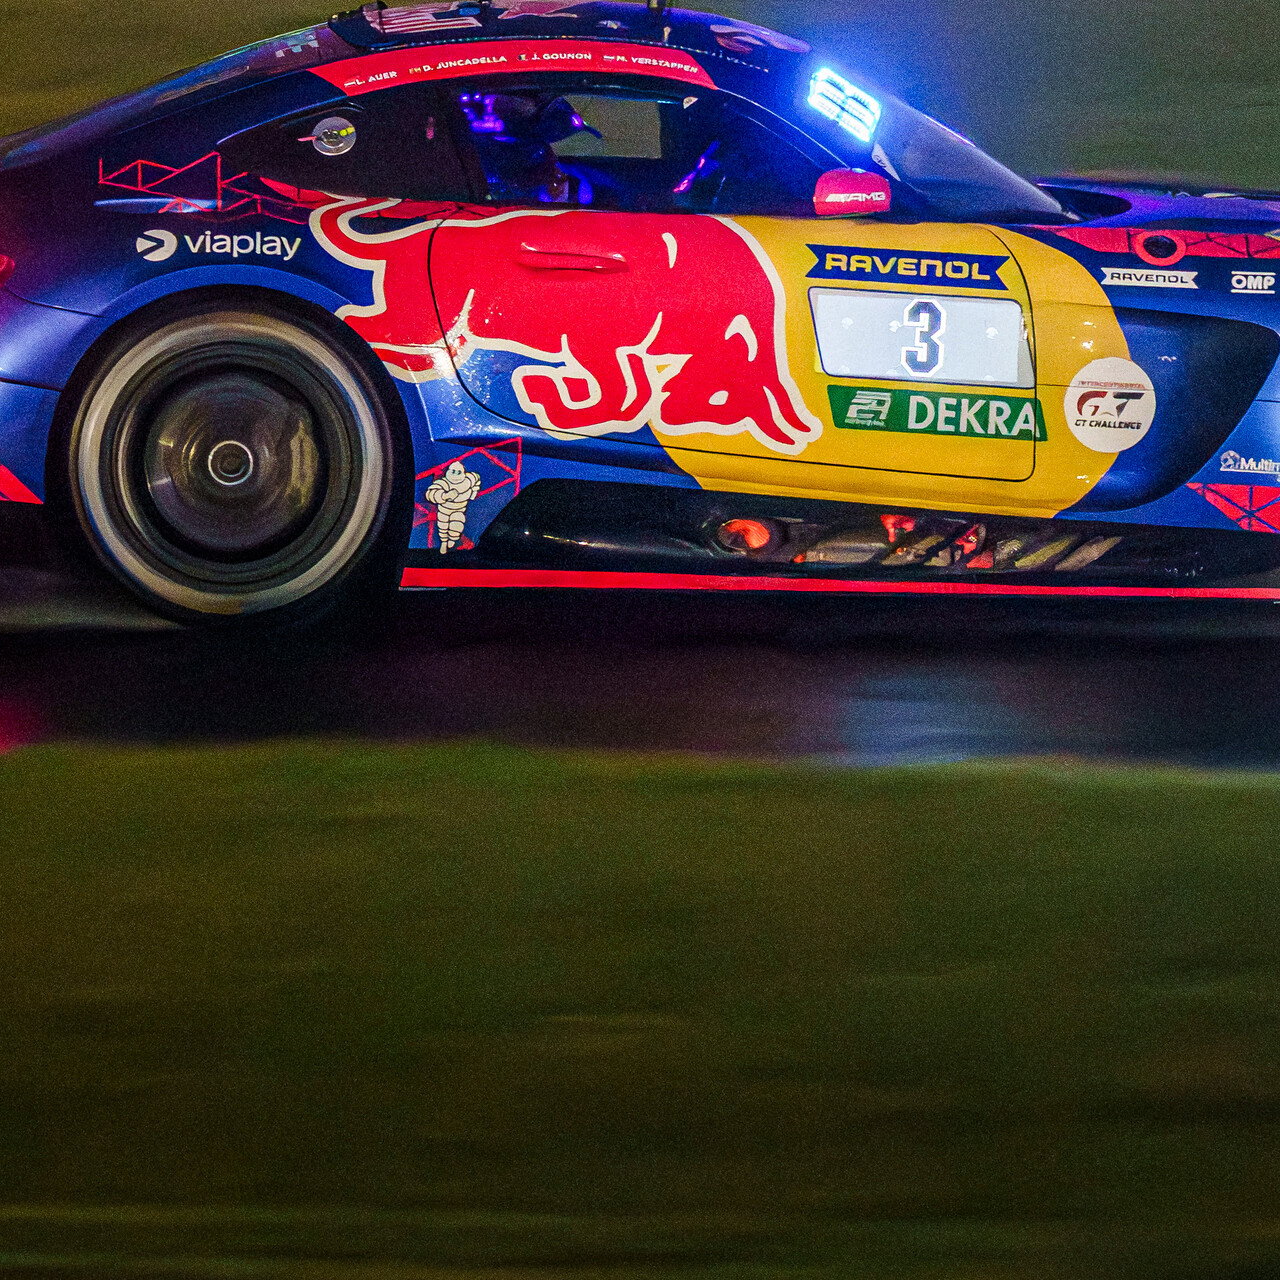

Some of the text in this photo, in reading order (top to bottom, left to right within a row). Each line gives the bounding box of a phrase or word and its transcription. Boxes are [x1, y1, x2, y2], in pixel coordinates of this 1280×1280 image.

[422, 55, 508, 73] D. JUNCADELLA
[542, 52, 592, 61] GOUNON
[631, 56, 699, 74] VERSTAPPEN
[368, 70, 398, 83] AUER
[184, 230, 302, 261] viaplay
[824, 252, 991, 281] RAVENOL
[1110, 272, 1189, 284] RAVENOL
[1231, 274, 1276, 290] OMP
[900, 299, 947, 378] 3
[907, 394, 1041, 438] DEKRA
[1074, 419, 1143, 430] GT CHALLENGE
